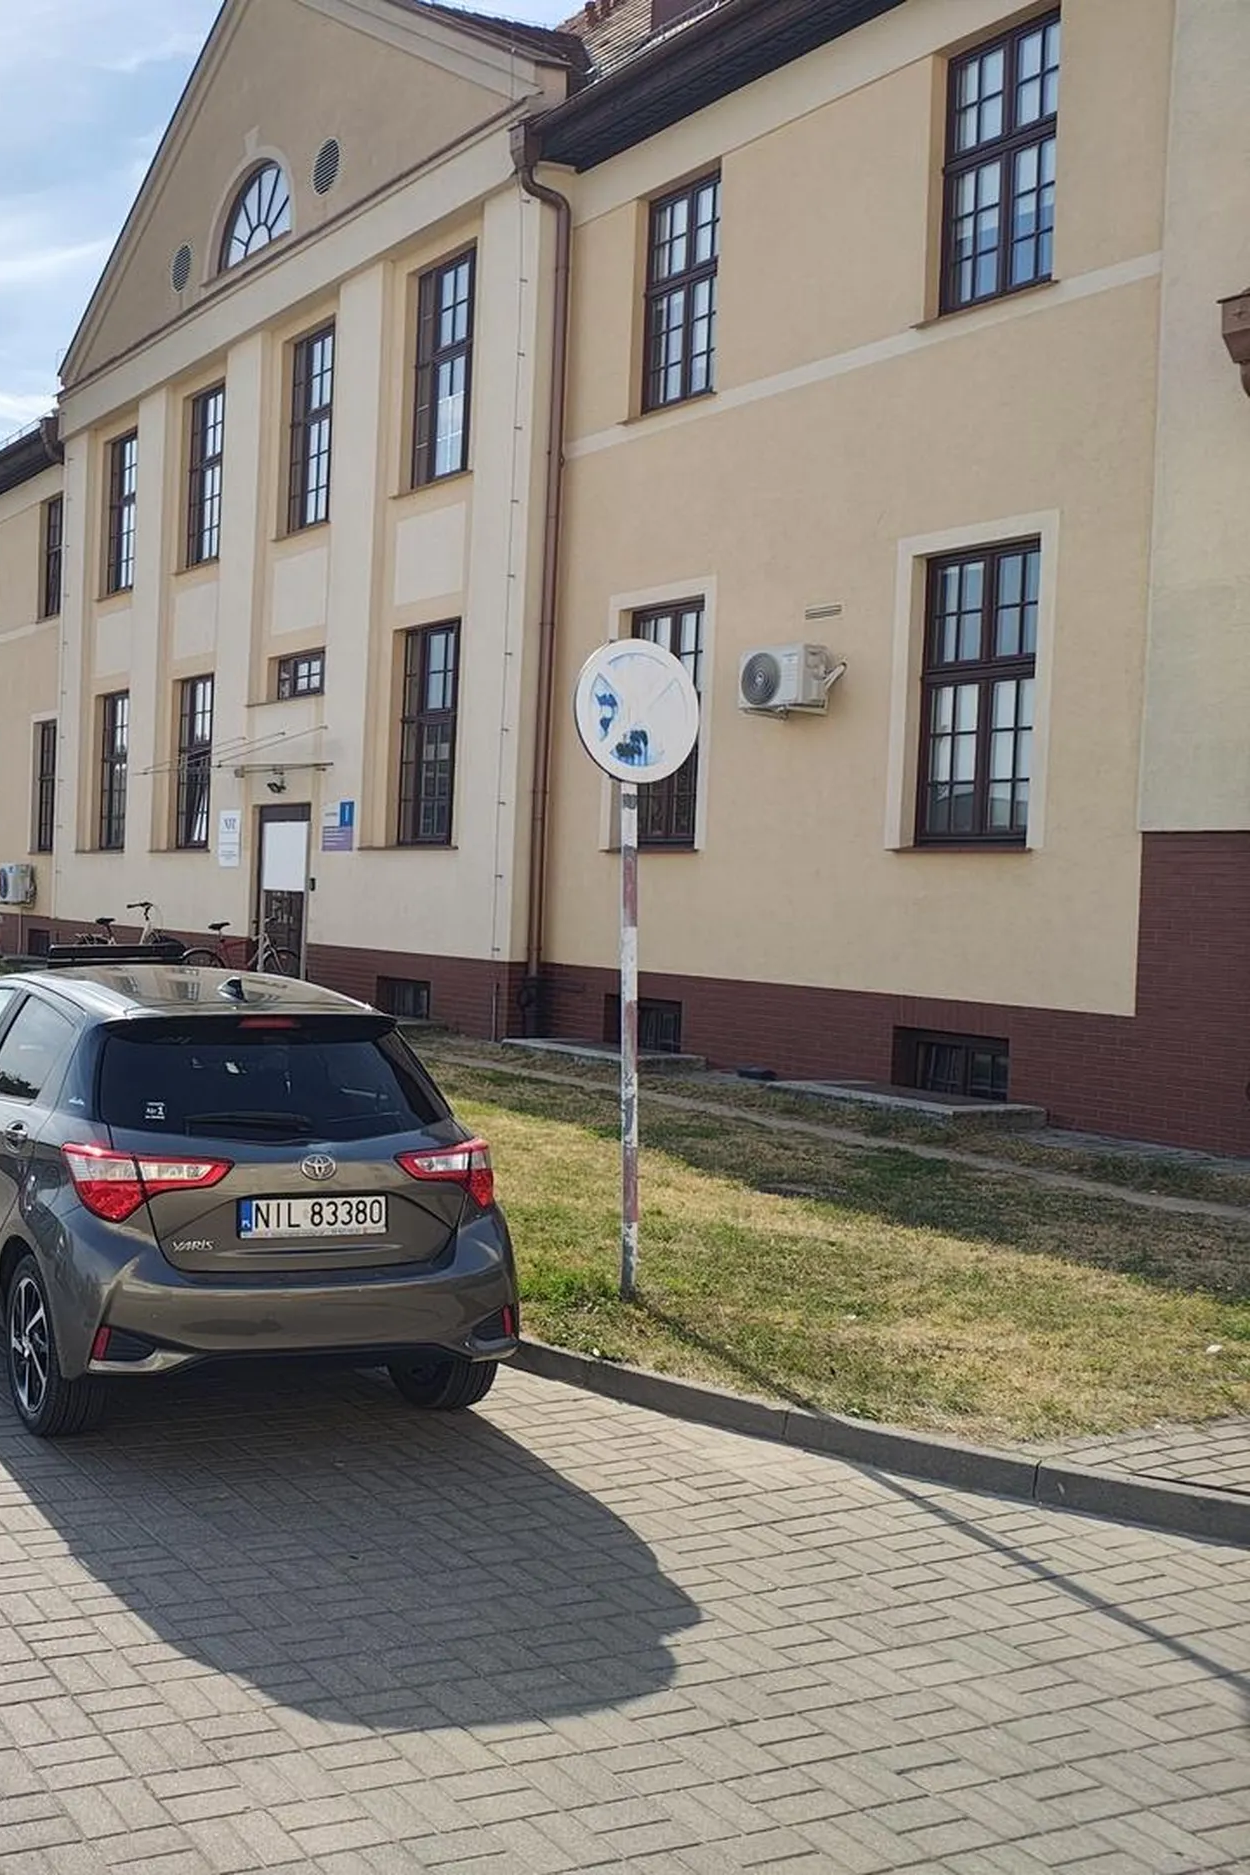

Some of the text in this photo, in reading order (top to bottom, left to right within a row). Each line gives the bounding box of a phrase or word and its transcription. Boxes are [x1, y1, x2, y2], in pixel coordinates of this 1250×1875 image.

[255, 1199, 382, 1228] NIL 83380
[172, 1239, 214, 1251] YARIS
